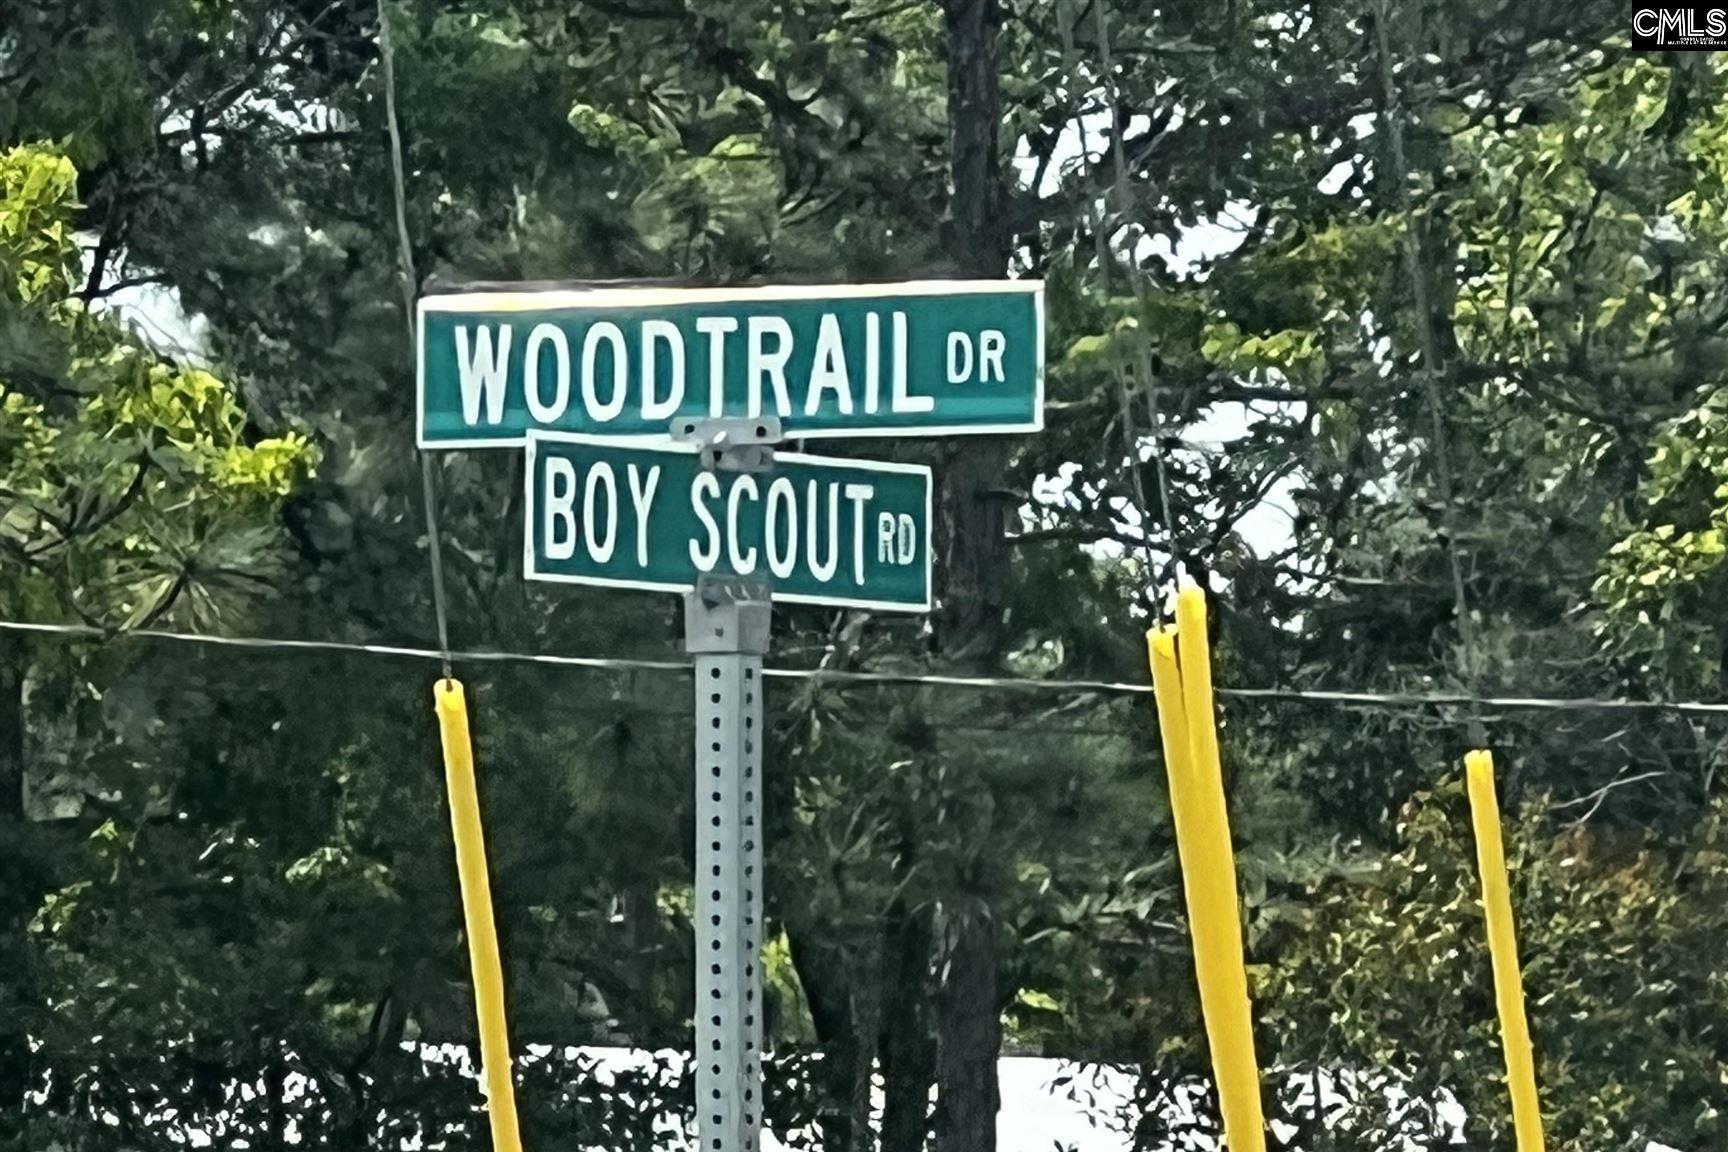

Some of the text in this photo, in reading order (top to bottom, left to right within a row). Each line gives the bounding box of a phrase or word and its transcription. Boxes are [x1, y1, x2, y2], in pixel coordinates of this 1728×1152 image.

[454, 311, 1007, 425] WOODTRAIL DR
[544, 456, 917, 586] BOY SCOUT RD
